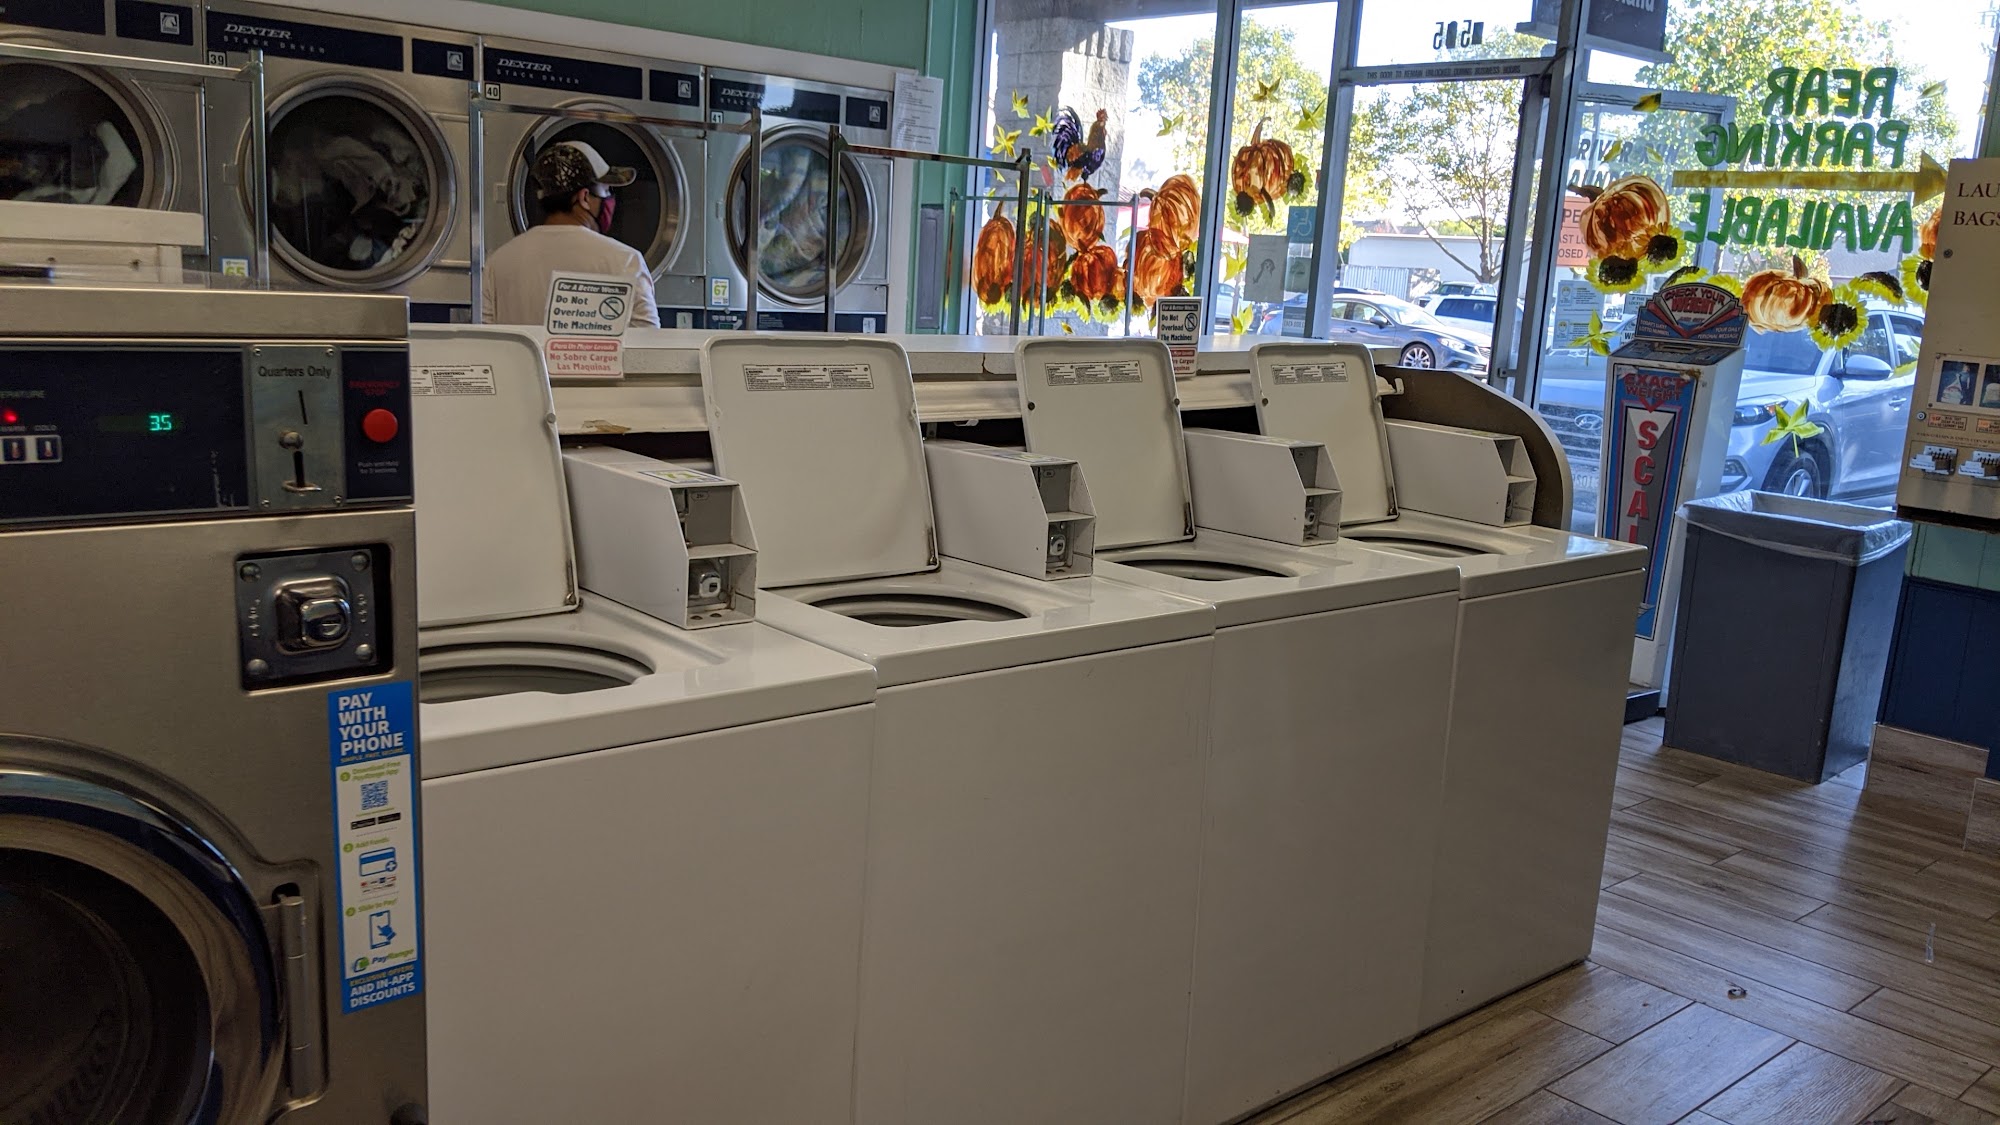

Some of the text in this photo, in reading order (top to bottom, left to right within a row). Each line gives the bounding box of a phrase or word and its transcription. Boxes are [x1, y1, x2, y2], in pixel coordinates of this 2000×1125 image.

[224, 23, 292, 40] DEXTER
[223, 35, 325, 54] STACK DRYER
[210, 54, 225, 65] 39
[497, 58, 553, 72] DEXTER
[496, 69, 580, 85] STACK DRYER
[1367, 71, 1378, 80] THIS
[1380, 70, 1393, 79] DOOR
[486, 87, 499, 98] 40
[712, 113, 721, 122] 41
[559, 282, 571, 291] For
[572, 283, 578, 291] A
[714, 285, 728, 296] 67
[556, 295, 589, 306] Do Not
[1664, 287, 1726, 306] CHECK YOUR
[553, 307, 597, 318] Overload
[552, 321, 613, 332] The Machines
[550, 353, 618, 363] No Sobre Cargue
[258, 365, 332, 379] Quarters Only
[573, 364, 612, 373] Maquinas
[1625, 384, 1682, 401] WEIGHT
[338, 692, 373, 711] PAY
[338, 705, 387, 726] WITH
[338, 720, 390, 740] YOUR
[340, 732, 404, 757] PHONE
[372, 949, 415, 966] PayRange
[350, 972, 415, 998] AND IN-APP
[350, 982, 416, 1009] DISCOUNTS
